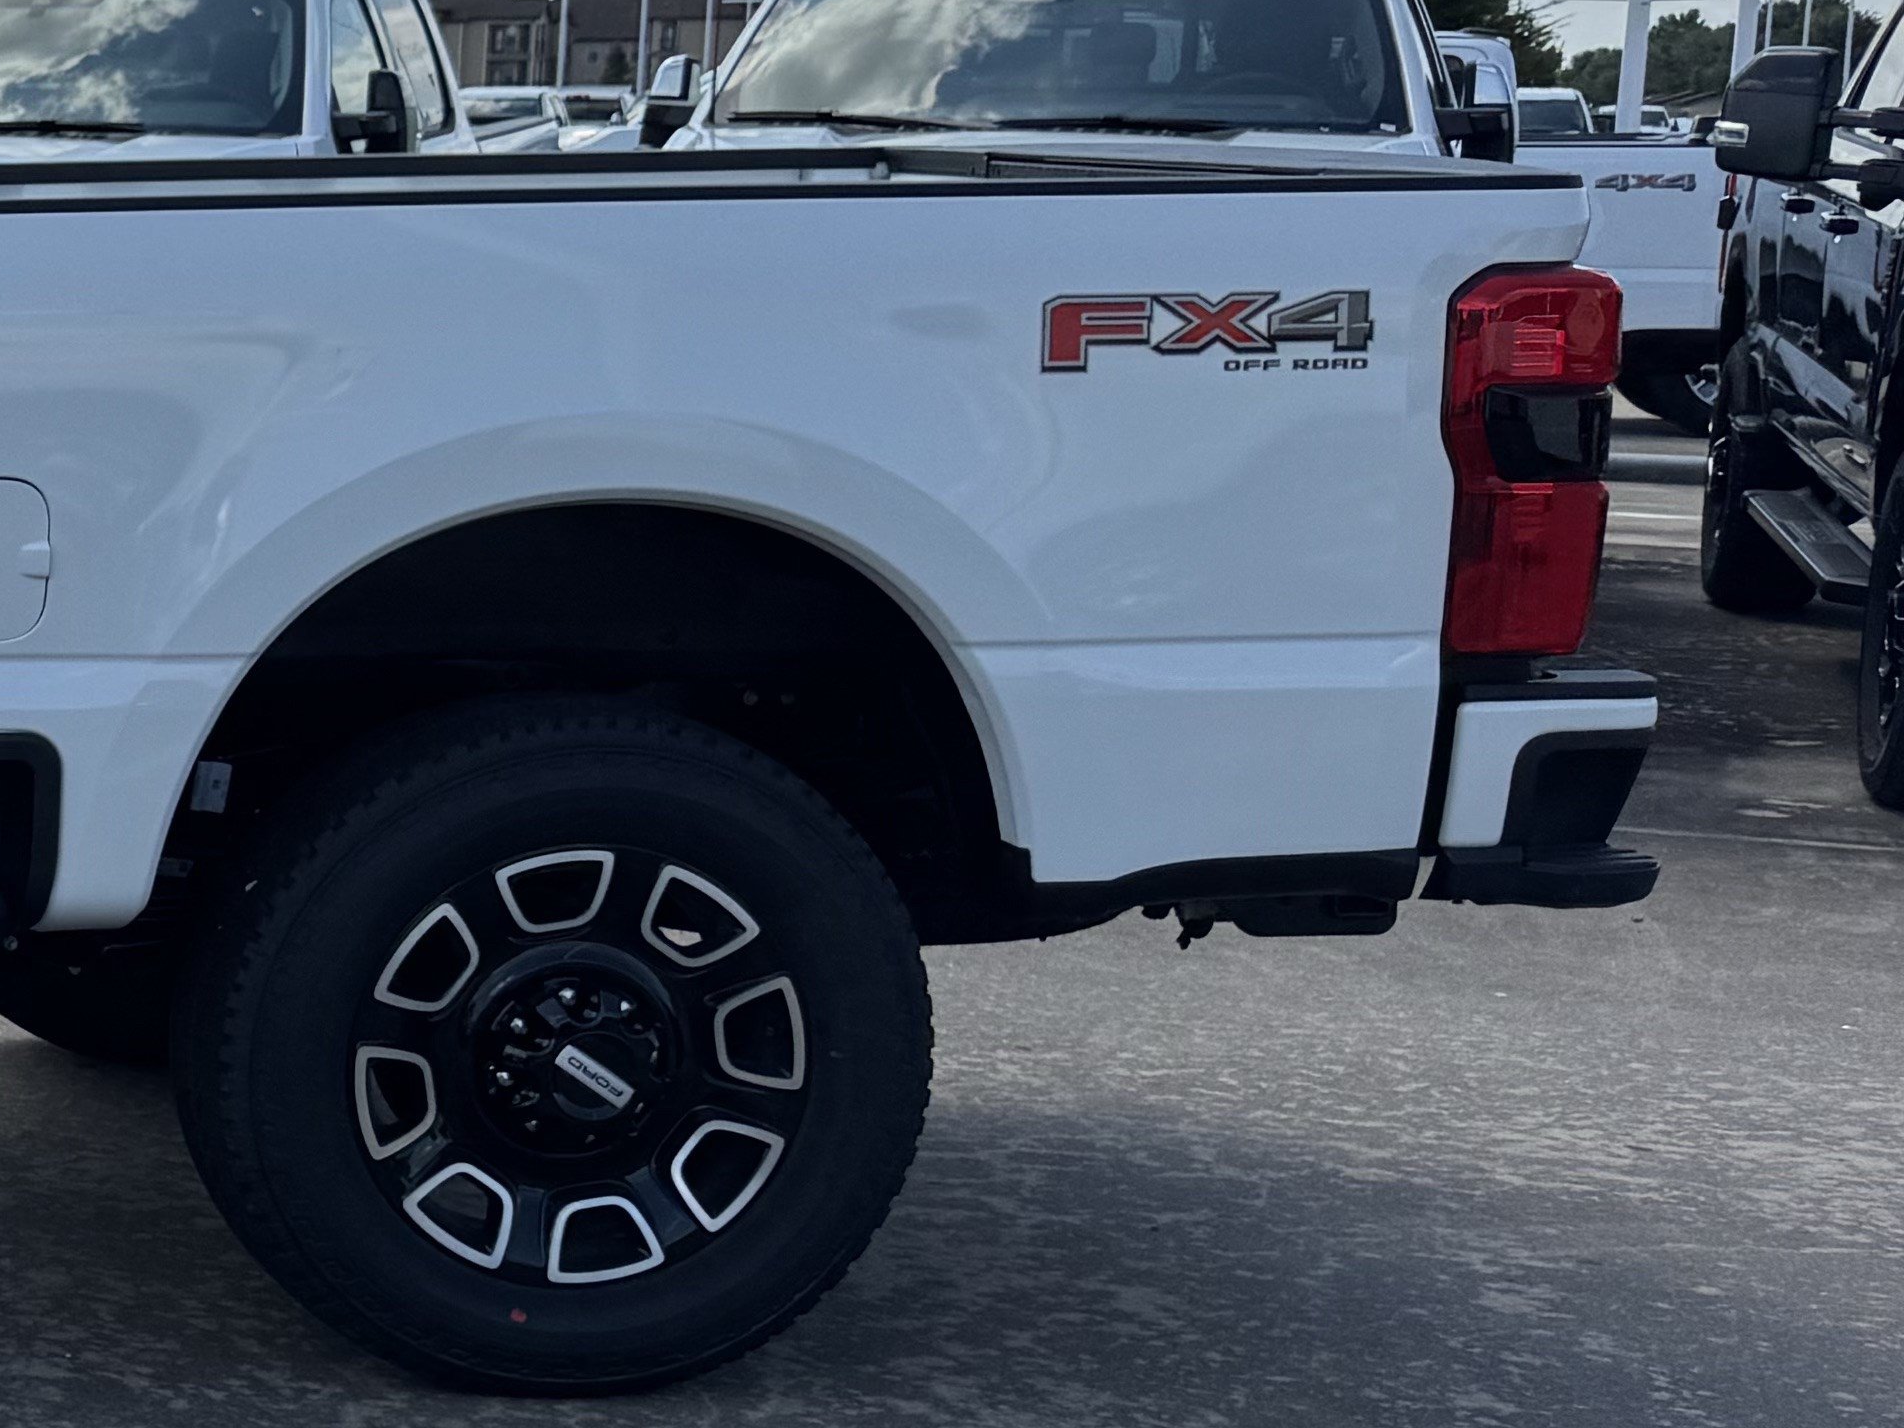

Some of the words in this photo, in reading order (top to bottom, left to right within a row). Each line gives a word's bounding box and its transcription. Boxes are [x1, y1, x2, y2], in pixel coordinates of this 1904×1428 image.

[1042, 290, 1374, 373] FX4
[1223, 358, 1282, 372] OFF
[1292, 357, 1369, 371] ROAD
[567, 1056, 624, 1098] FORD
